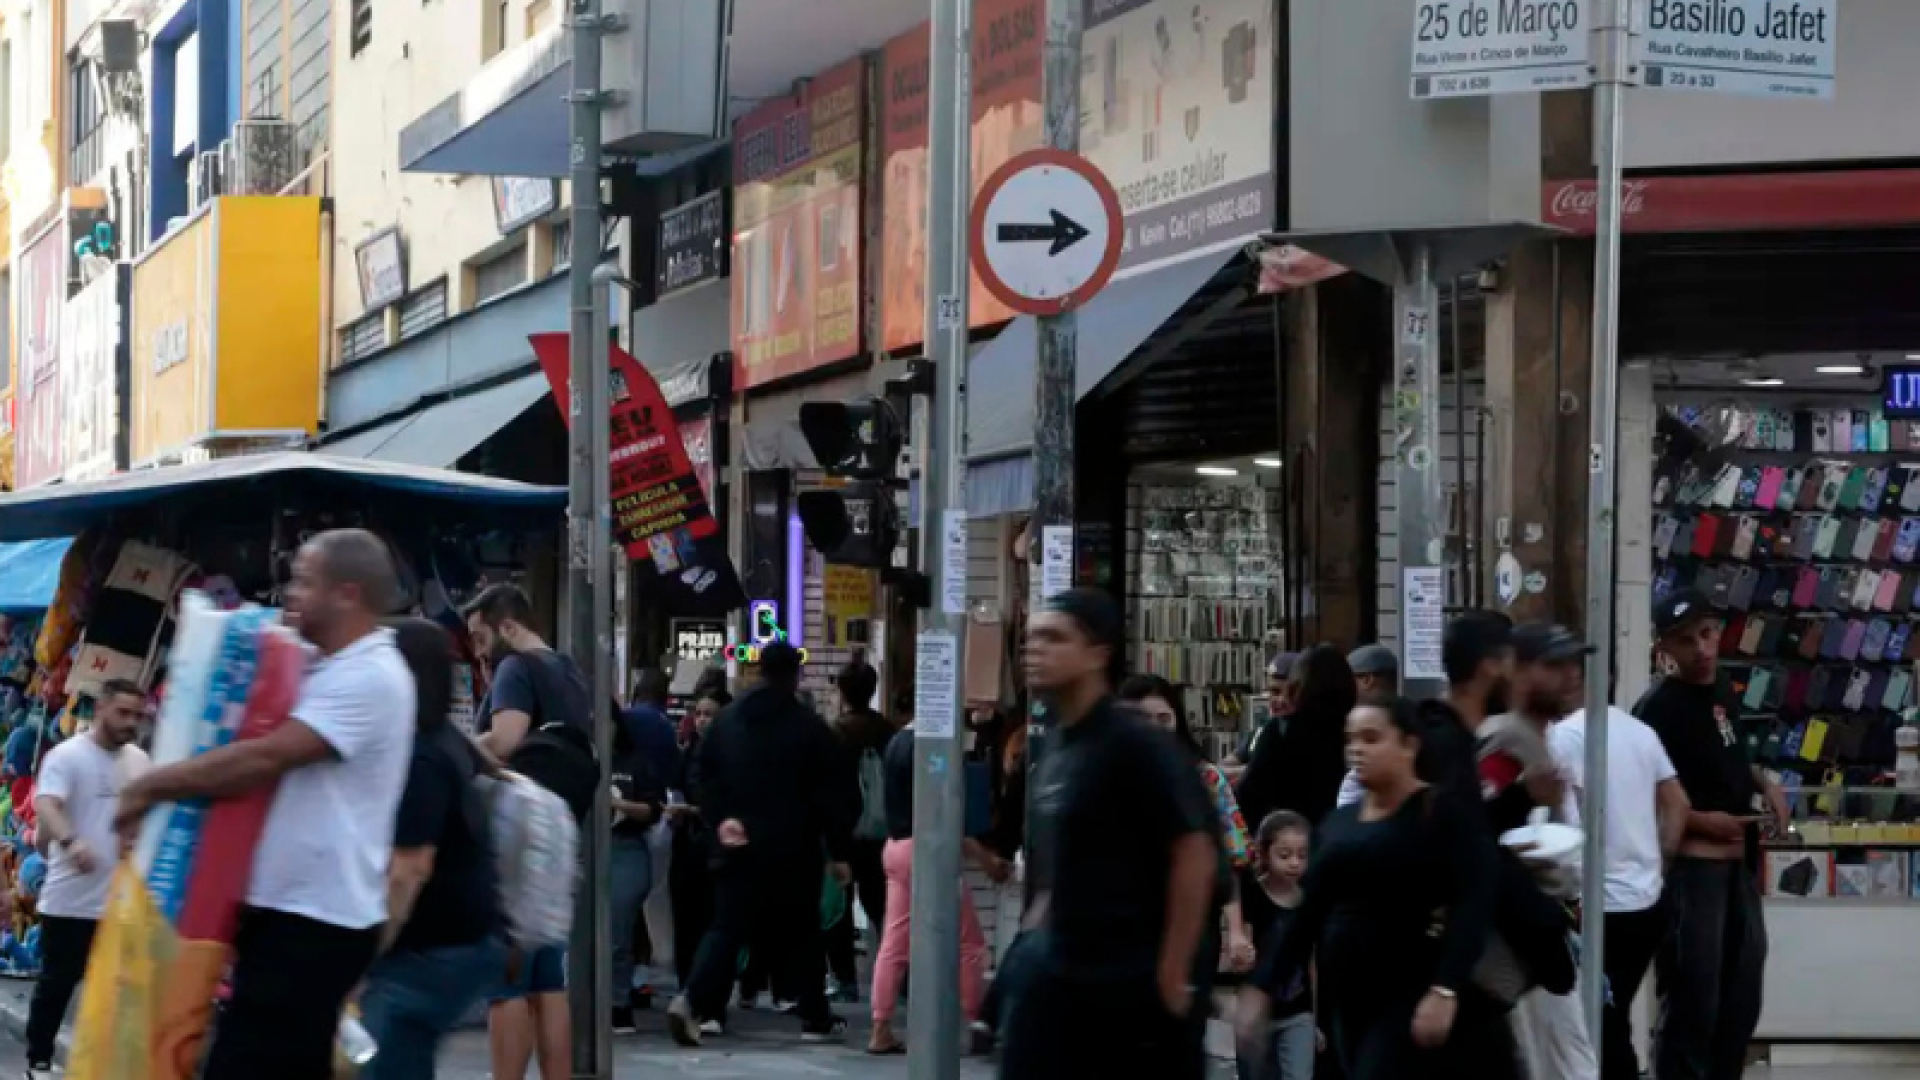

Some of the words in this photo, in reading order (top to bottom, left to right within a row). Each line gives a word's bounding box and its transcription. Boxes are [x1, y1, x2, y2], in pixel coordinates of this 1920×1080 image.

[1418, 5, 1448, 41] 25
[1459, 0, 1488, 37] de
[1497, 0, 1578, 41] Março
[1754, 0, 1828, 43] Jafet
[1649, 40, 1673, 55] Rua
